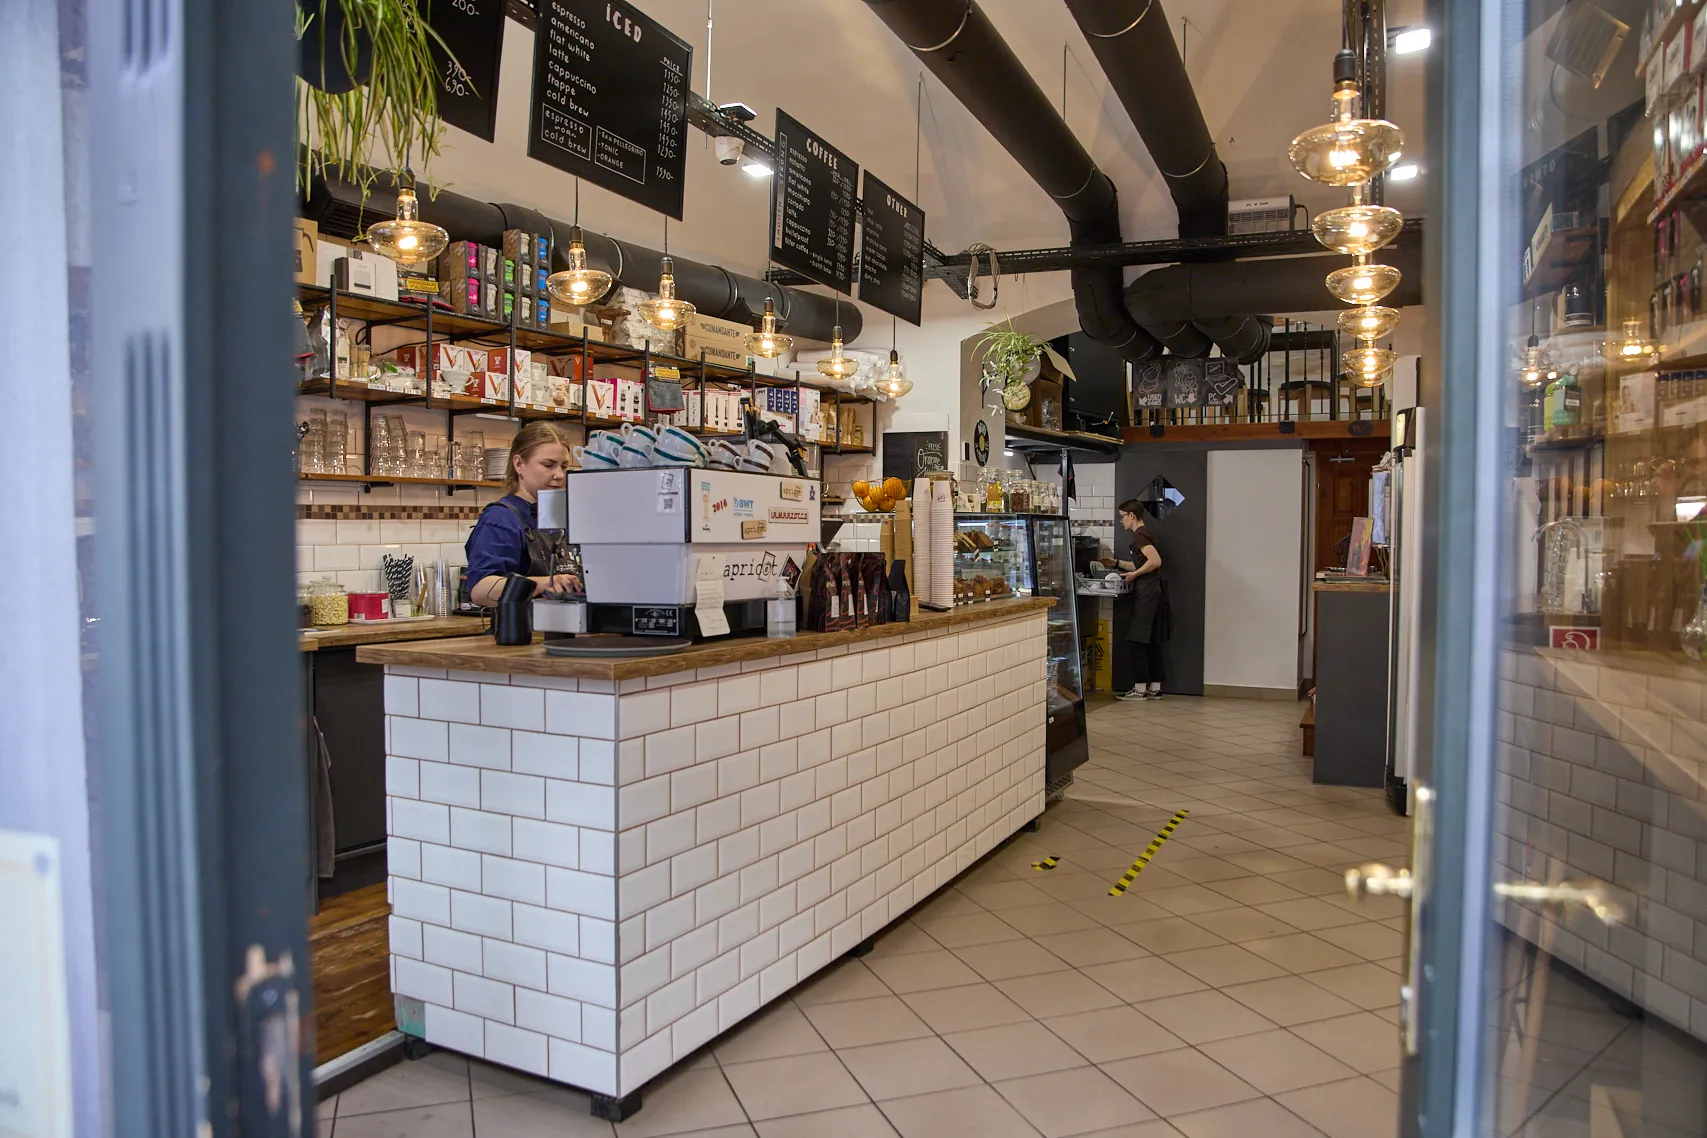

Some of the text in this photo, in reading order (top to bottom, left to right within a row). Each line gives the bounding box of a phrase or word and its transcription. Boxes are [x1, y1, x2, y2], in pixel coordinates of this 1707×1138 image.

[551, 1, 586, 29] espresso
[550, 17, 595, 50] americano
[550, 29, 591, 62] flat white
[549, 43, 570, 63] latte
[445, 77, 470, 96] 690-
[547, 73, 576, 96] frappe
[548, 60, 597, 95] cappuccino
[546, 89, 590, 117] cold brew
[545, 110, 584, 134] espresso
[544, 129, 587, 154] cold brew
[806, 138, 838, 170] COFFEE
[886, 194, 908, 218] OTHER
[705, 322, 736, 338] COMANDANTE
[705, 345, 736, 361] COMANDANTE
[1174, 393, 1186, 405] WC
[712, 498, 728, 513] 2016
[739, 498, 754, 509] BWT
[723, 555, 778, 581] apricot
